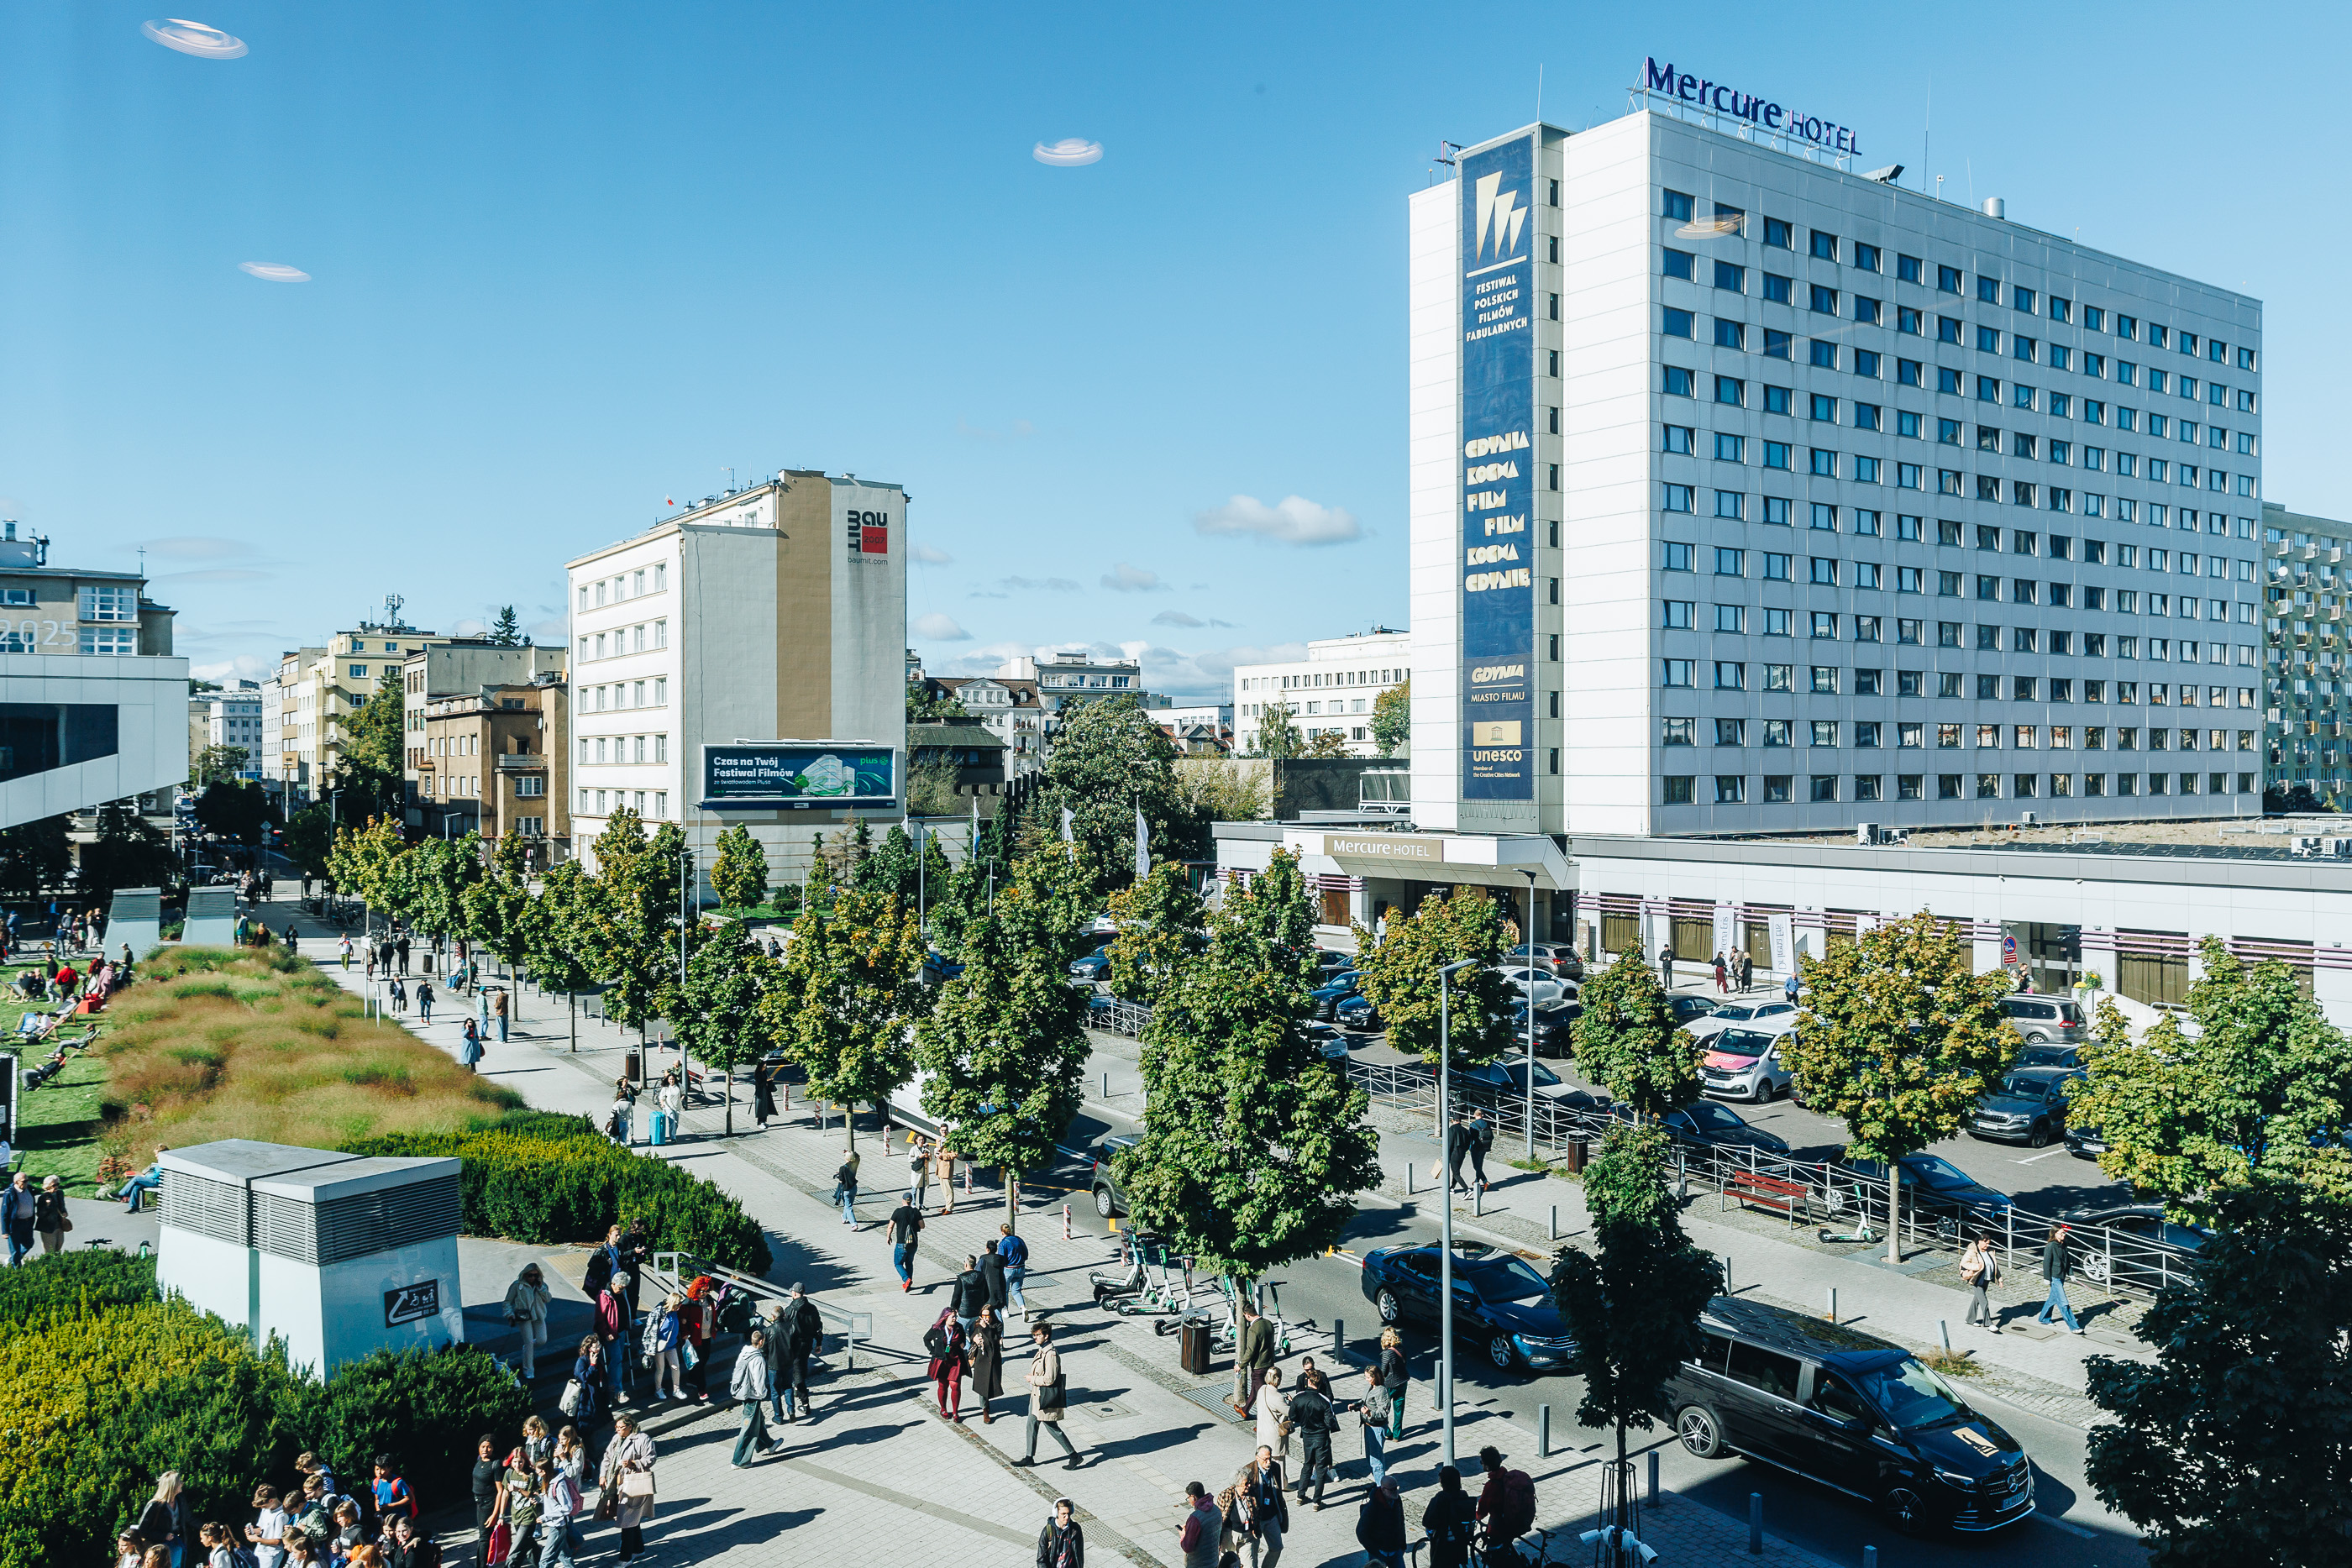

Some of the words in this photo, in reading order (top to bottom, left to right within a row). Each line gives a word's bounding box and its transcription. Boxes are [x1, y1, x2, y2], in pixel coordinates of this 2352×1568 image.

[1646, 56, 1782, 128] Mercure
[1789, 109, 1862, 156] HOTEL
[1476, 275, 1516, 295] FESTIWAL
[1474, 289, 1519, 311] POLSKICH
[1478, 305, 1514, 324] FILMÓW
[1466, 317, 1527, 342] FABULARNYCH
[1465, 430, 1530, 459] GDYNIA
[1467, 489, 1506, 512] FILM
[1484, 513, 1525, 537] FILM
[848, 556, 888, 565] baumit.com
[0, 618, 78, 646] 2025
[1472, 664, 1524, 684] GDYNIA
[1471, 693, 1499, 702] MIASTO
[1501, 691, 1525, 701] FILMU
[714, 757, 738, 766] Czas
[754, 757, 778, 768] Twój
[860, 756, 878, 765] plus
[1473, 749, 1522, 763] unesco
[714, 768, 756, 777] Festiwal
[758, 768, 794, 777] Filmów
[1334, 840, 1391, 855] Mercure
[1394, 845, 1431, 856] HOTEL
[1719, 916, 1729, 930] Eris
